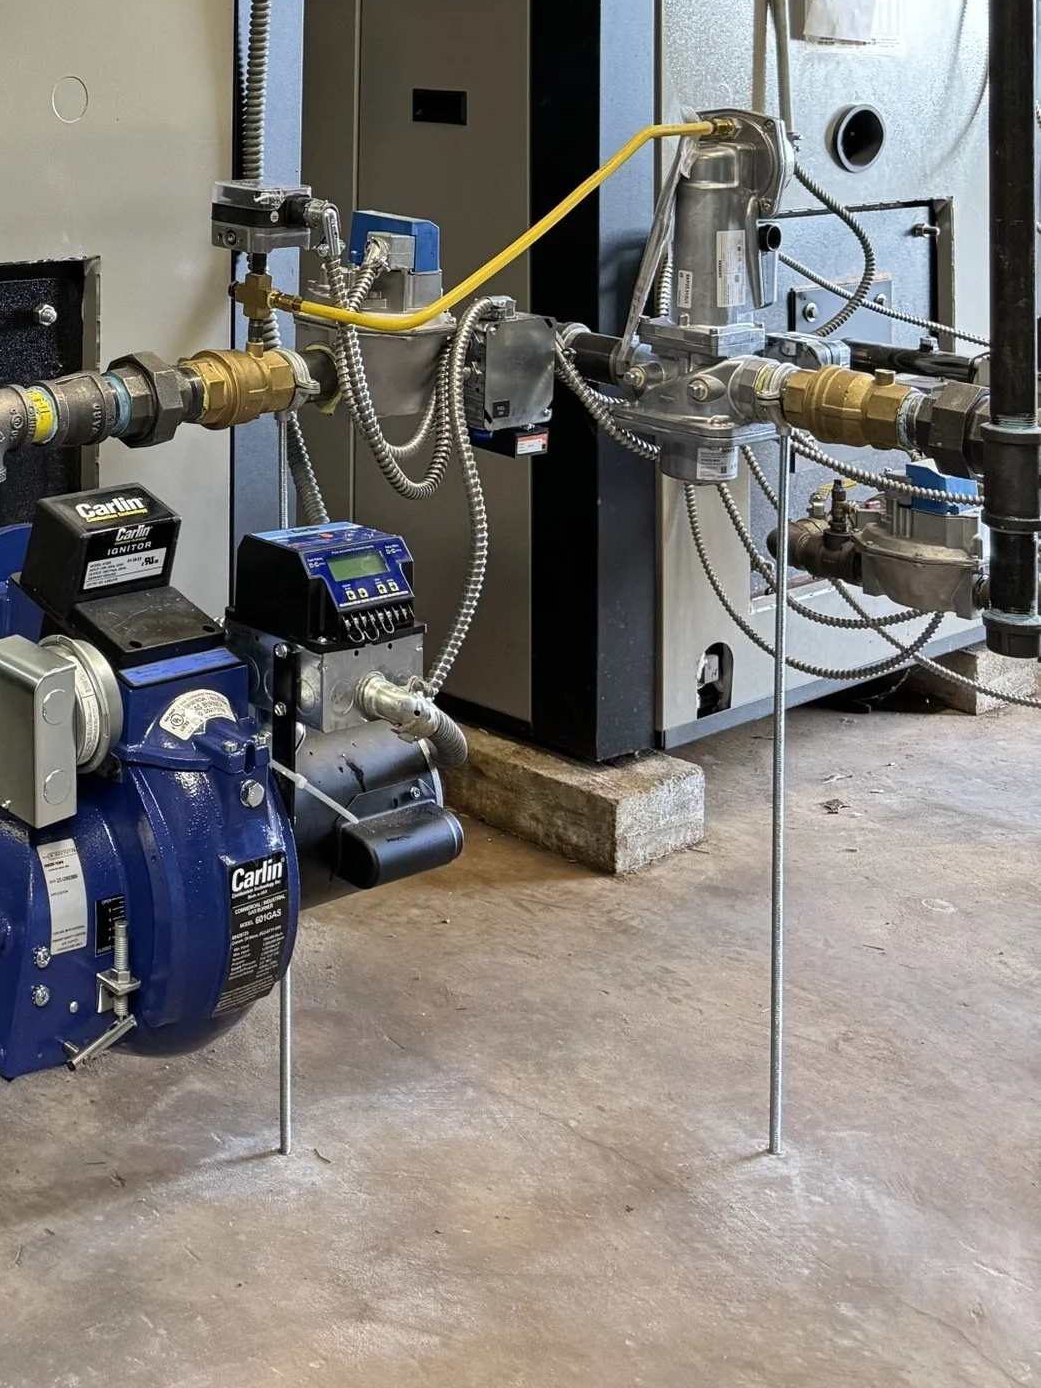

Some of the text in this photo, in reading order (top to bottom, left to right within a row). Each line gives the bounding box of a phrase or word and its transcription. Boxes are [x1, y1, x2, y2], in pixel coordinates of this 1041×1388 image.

[75, 497, 142, 518] Carlin
[116, 524, 150, 541] Carlin
[107, 541, 152, 556] IGNITOR
[232, 859, 282, 892] Carlin
[232, 888, 253, 899] Combustion
[254, 882, 274, 891] Technology
[234, 895, 285, 914] COMMERCIAL INDUSTRIAL
[257, 903, 274, 912] BURNER
[240, 909, 281, 928] MODEL 601GAS
